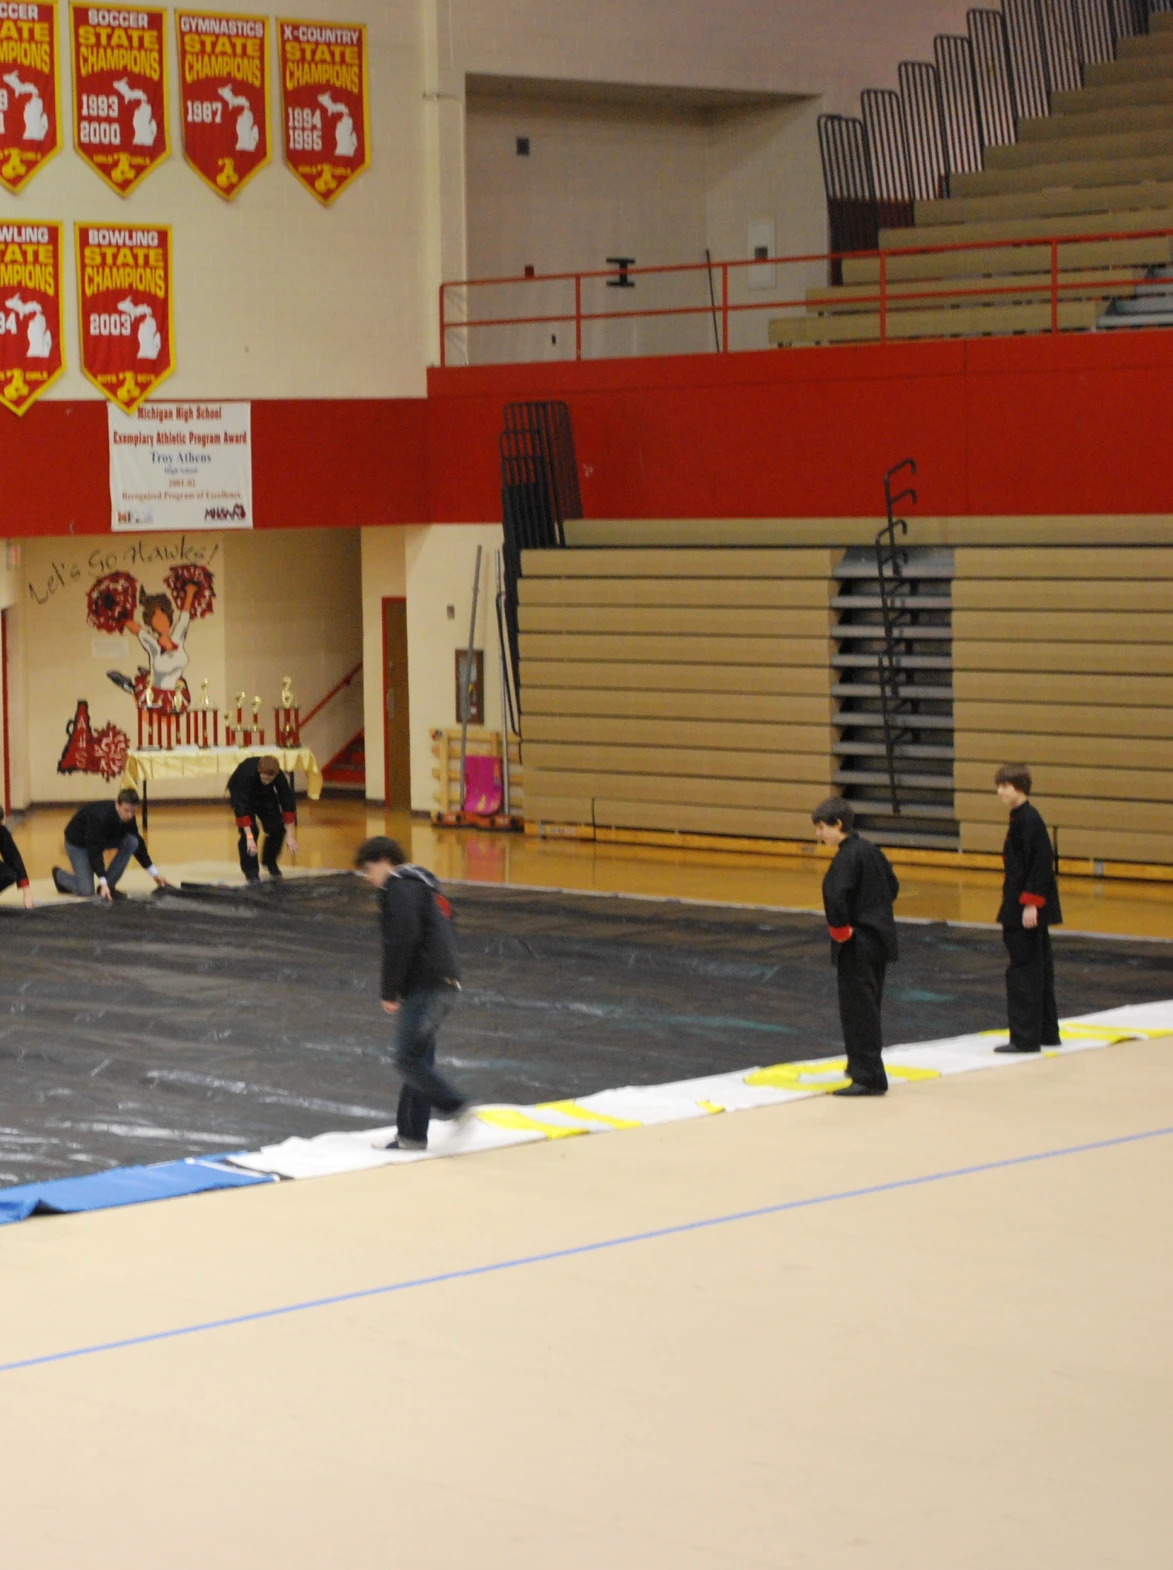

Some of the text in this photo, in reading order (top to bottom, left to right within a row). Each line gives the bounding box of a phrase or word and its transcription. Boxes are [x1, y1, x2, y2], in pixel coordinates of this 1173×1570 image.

[88, 9, 148, 28] SOCCER
[180, 16, 264, 38] GYMNASTICS
[78, 25, 159, 49] STATE
[183, 33, 260, 57] STATE
[283, 24, 360, 45] X-COUNTRY
[79, 46, 160, 82] CHAMPIONS
[285, 41, 359, 64] STATE
[184, 53, 261, 88] CHAMPIONS
[285, 61, 359, 95] CHAMPIONS
[81, 93, 119, 117] 1993
[287, 107, 323, 129] 1994
[80, 121, 121, 145] 2000
[88, 229, 159, 247] BOWLING
[84, 246, 165, 267] STATE
[85, 266, 165, 299] CHAMPIONS
[89, 313, 132, 336] 2003
[137, 406, 223, 423] Michigan High School
[113, 430, 247, 448] Exemplary Athletic Program Award
[151, 452, 212, 467] Troy Athens
[28, 562, 80, 605] Let's
[88, 549, 118, 573] Go
